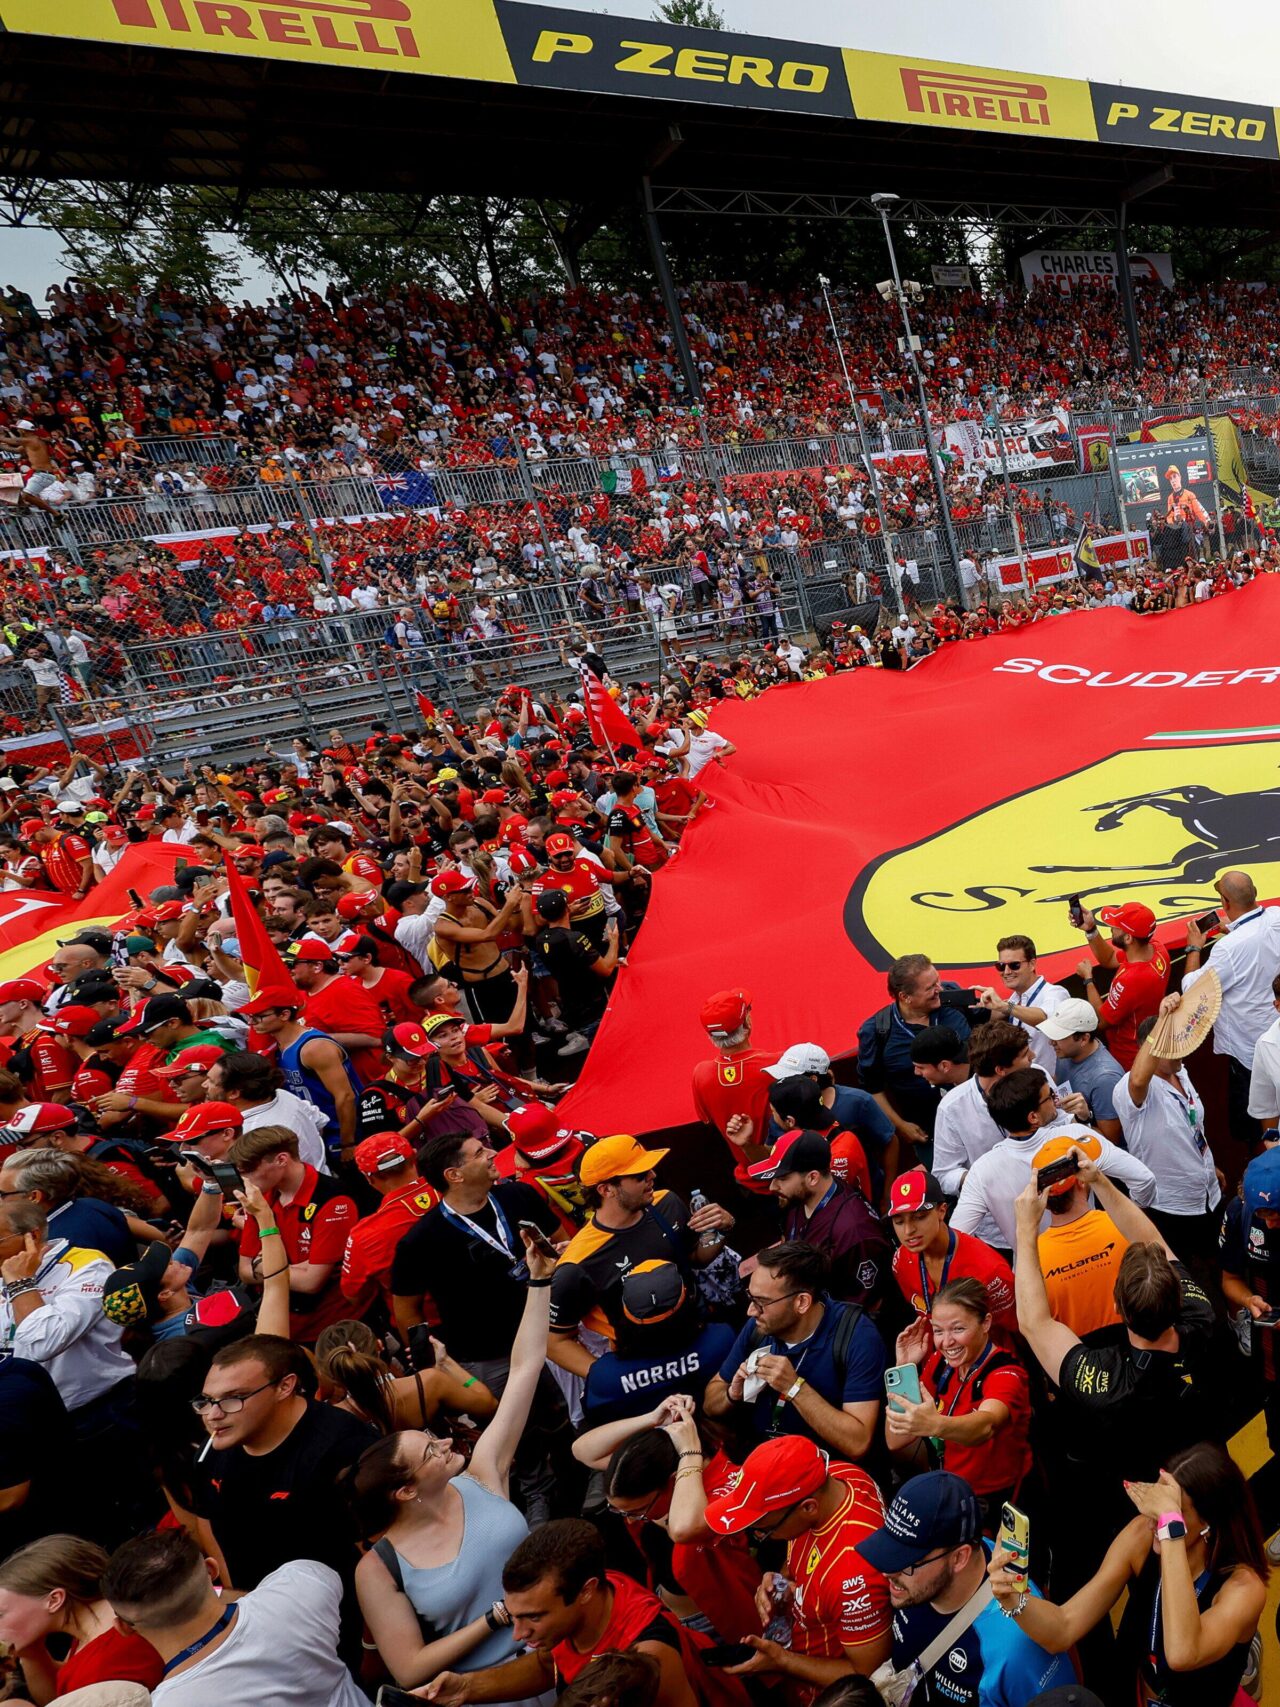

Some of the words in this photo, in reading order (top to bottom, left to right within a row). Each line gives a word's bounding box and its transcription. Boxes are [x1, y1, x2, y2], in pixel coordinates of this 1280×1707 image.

[532, 30, 593, 63] P
[615, 41, 830, 93] ZERO
[900, 67, 1051, 126] PIRELLI
[1106, 102, 1140, 126] P
[1151, 107, 1266, 142] ZERO
[1041, 255, 1113, 273] CHARLES
[1045, 1249, 1110, 1279] McLaren
[987, 1277, 1002, 1290] aws
[1061, 1269, 1088, 1282] FORMULA
[621, 1352, 700, 1394] NORRIS
[1100, 1371, 1108, 1393] aws
[842, 1575, 865, 1590] aws
[842, 1594, 871, 1613] DXC
[949, 1652, 967, 1669] Gulf
[935, 1671, 973, 1699] WILLIAMS
[935, 1683, 966, 1704] RACING
